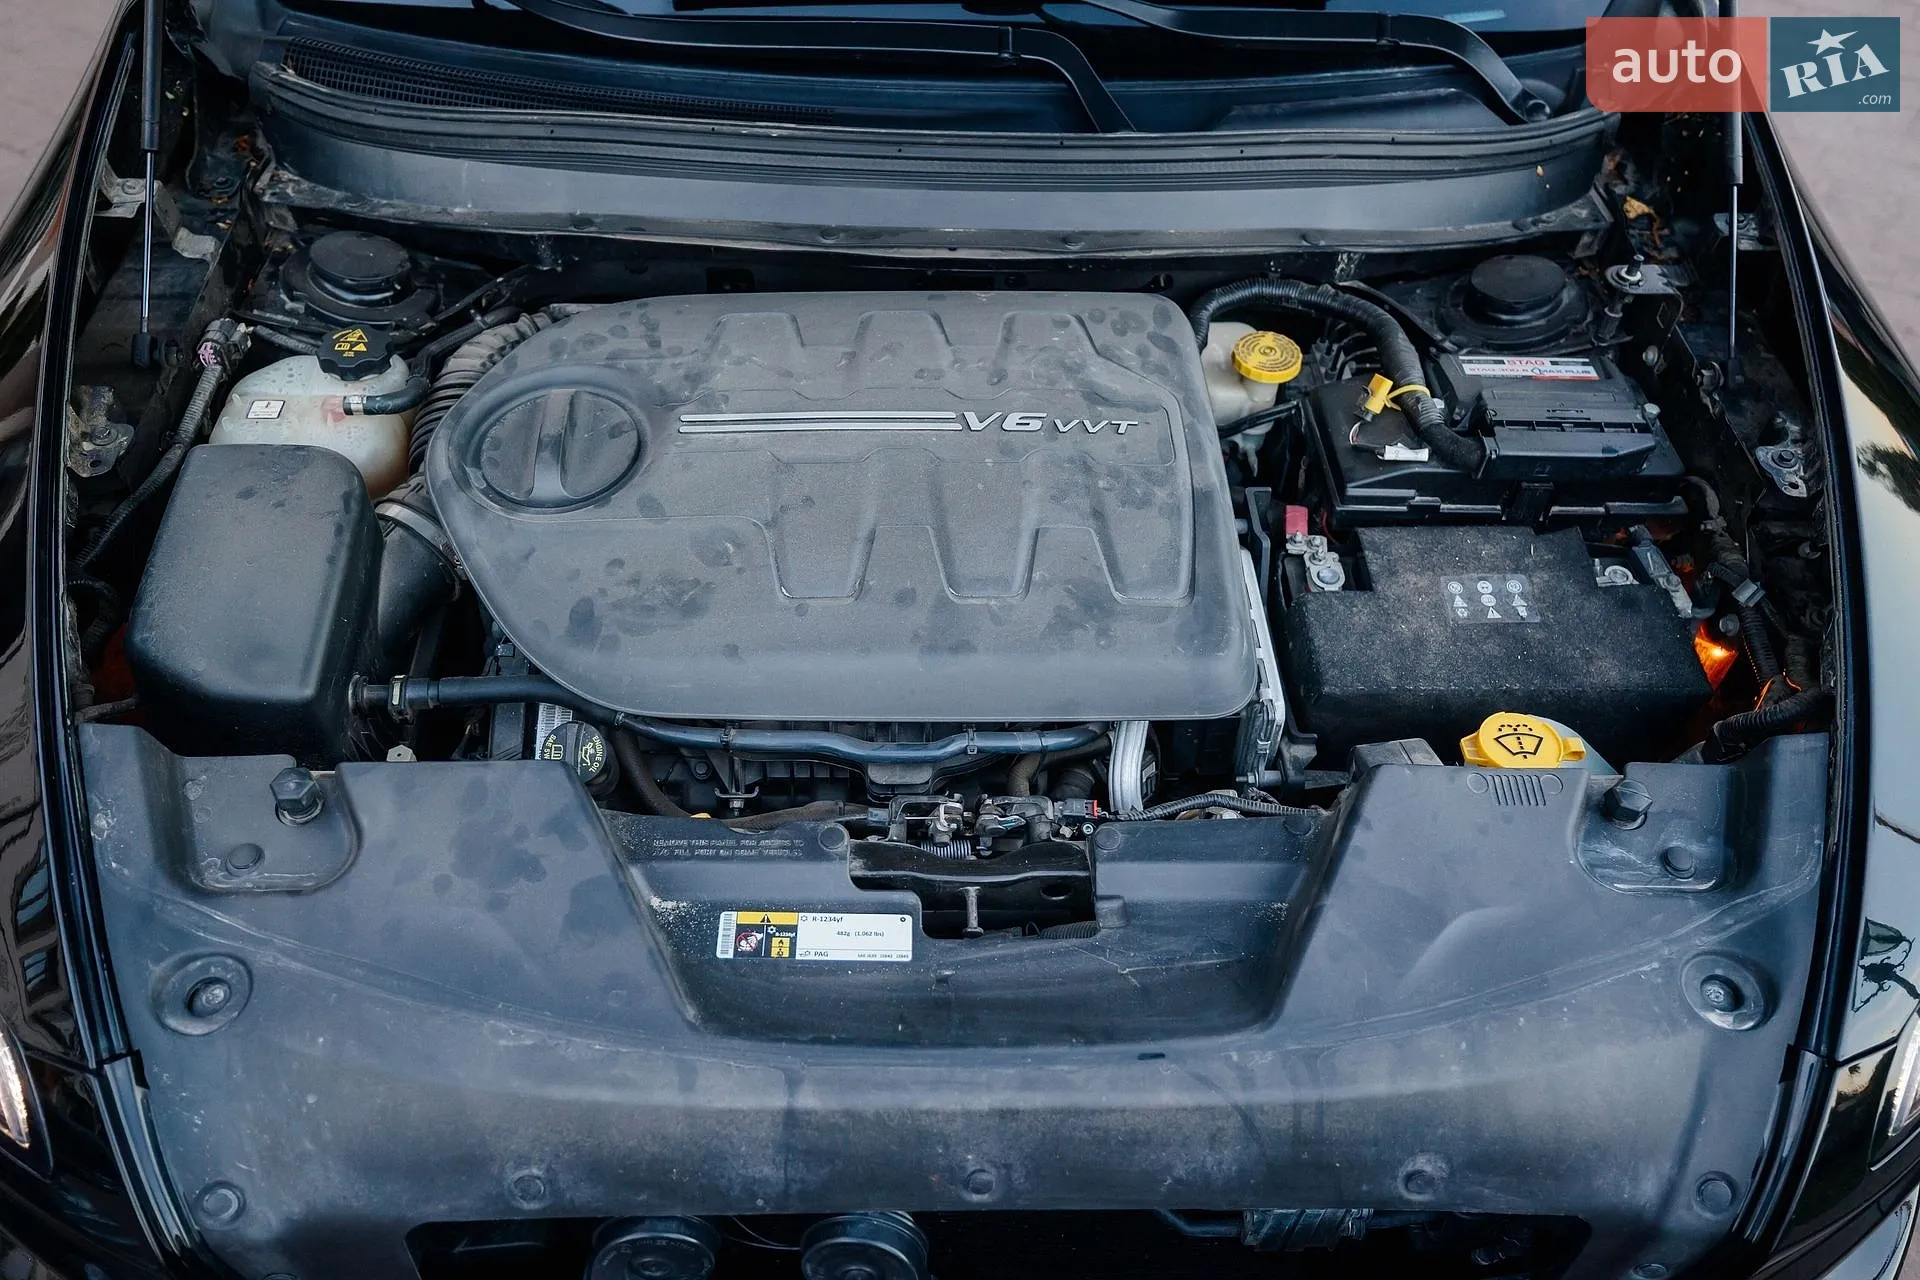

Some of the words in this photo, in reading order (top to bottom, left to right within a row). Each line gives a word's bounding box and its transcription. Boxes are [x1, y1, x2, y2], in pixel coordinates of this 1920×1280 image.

[963, 411, 1048, 432] V6
[1053, 418, 1139, 434] VVT
[545, 734, 557, 747] SAE
[592, 735, 603, 761] ENGINE
[588, 762, 600, 773] OIL
[811, 915, 844, 923] R-1234yf
